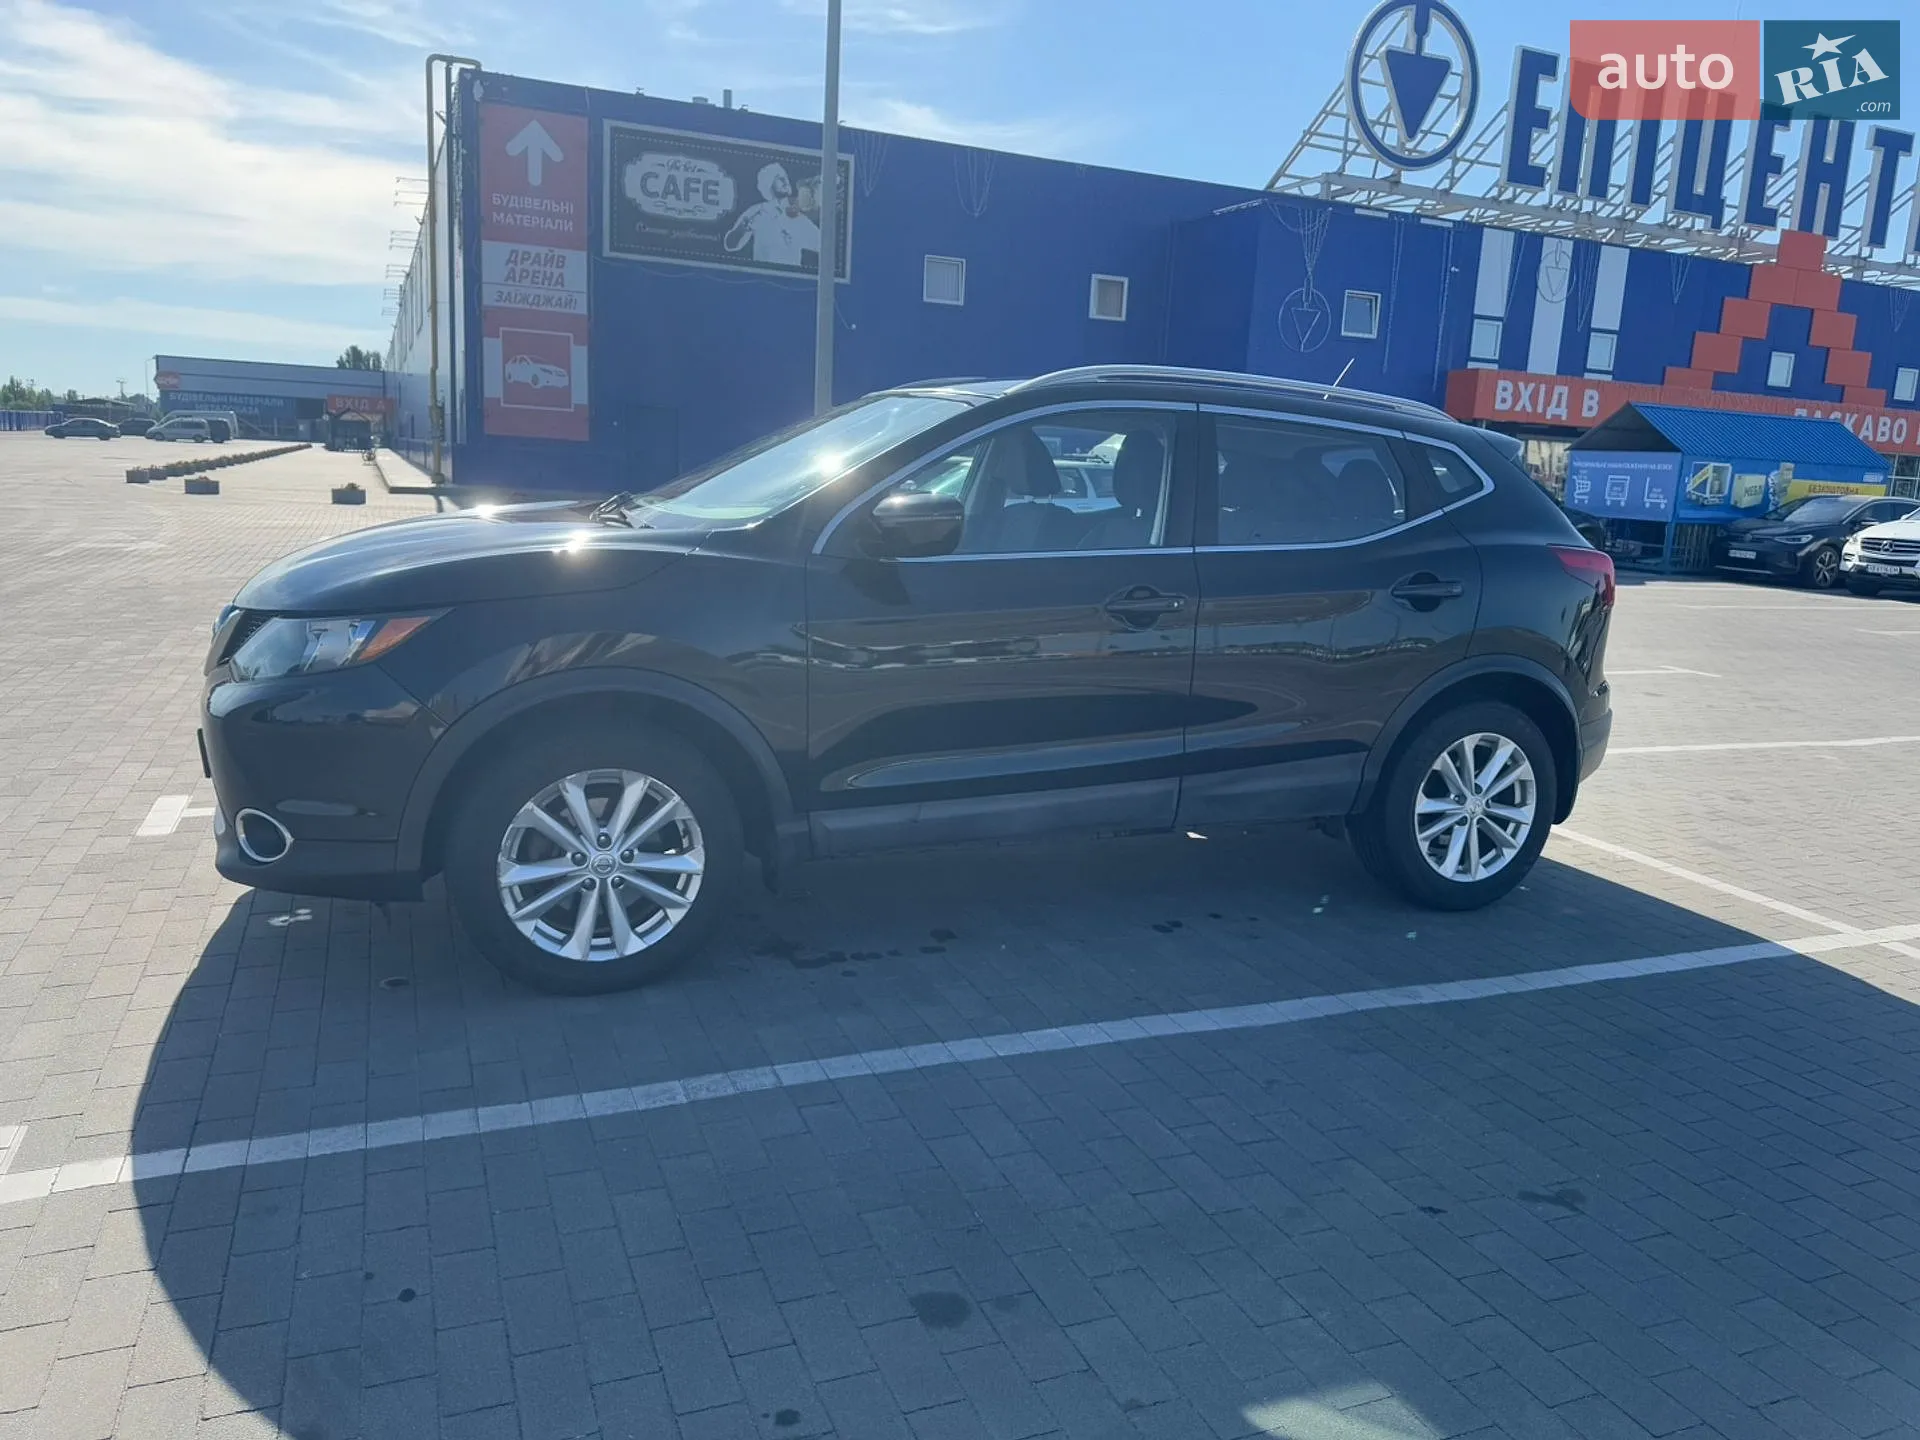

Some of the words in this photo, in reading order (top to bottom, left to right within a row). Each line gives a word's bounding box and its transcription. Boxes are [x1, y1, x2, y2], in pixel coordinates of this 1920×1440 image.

[1503, 45, 1920, 257] ЕПІЦЕНТ
[640, 171, 720, 206] CAFE
[492, 193, 574, 216] БУДІВЕЛЬНІ
[492, 212, 573, 232] МАТЕРІАЛИ
[505, 249, 567, 269] ДРАЙВ
[503, 267, 565, 288] АРЕНА
[494, 289, 577, 311] ЗАЇЖДЖАЙ!
[335, 396, 370, 411] ВХІД
[1494, 380, 1568, 420] ВХІД
[1794, 408, 1908, 444] КАВО
